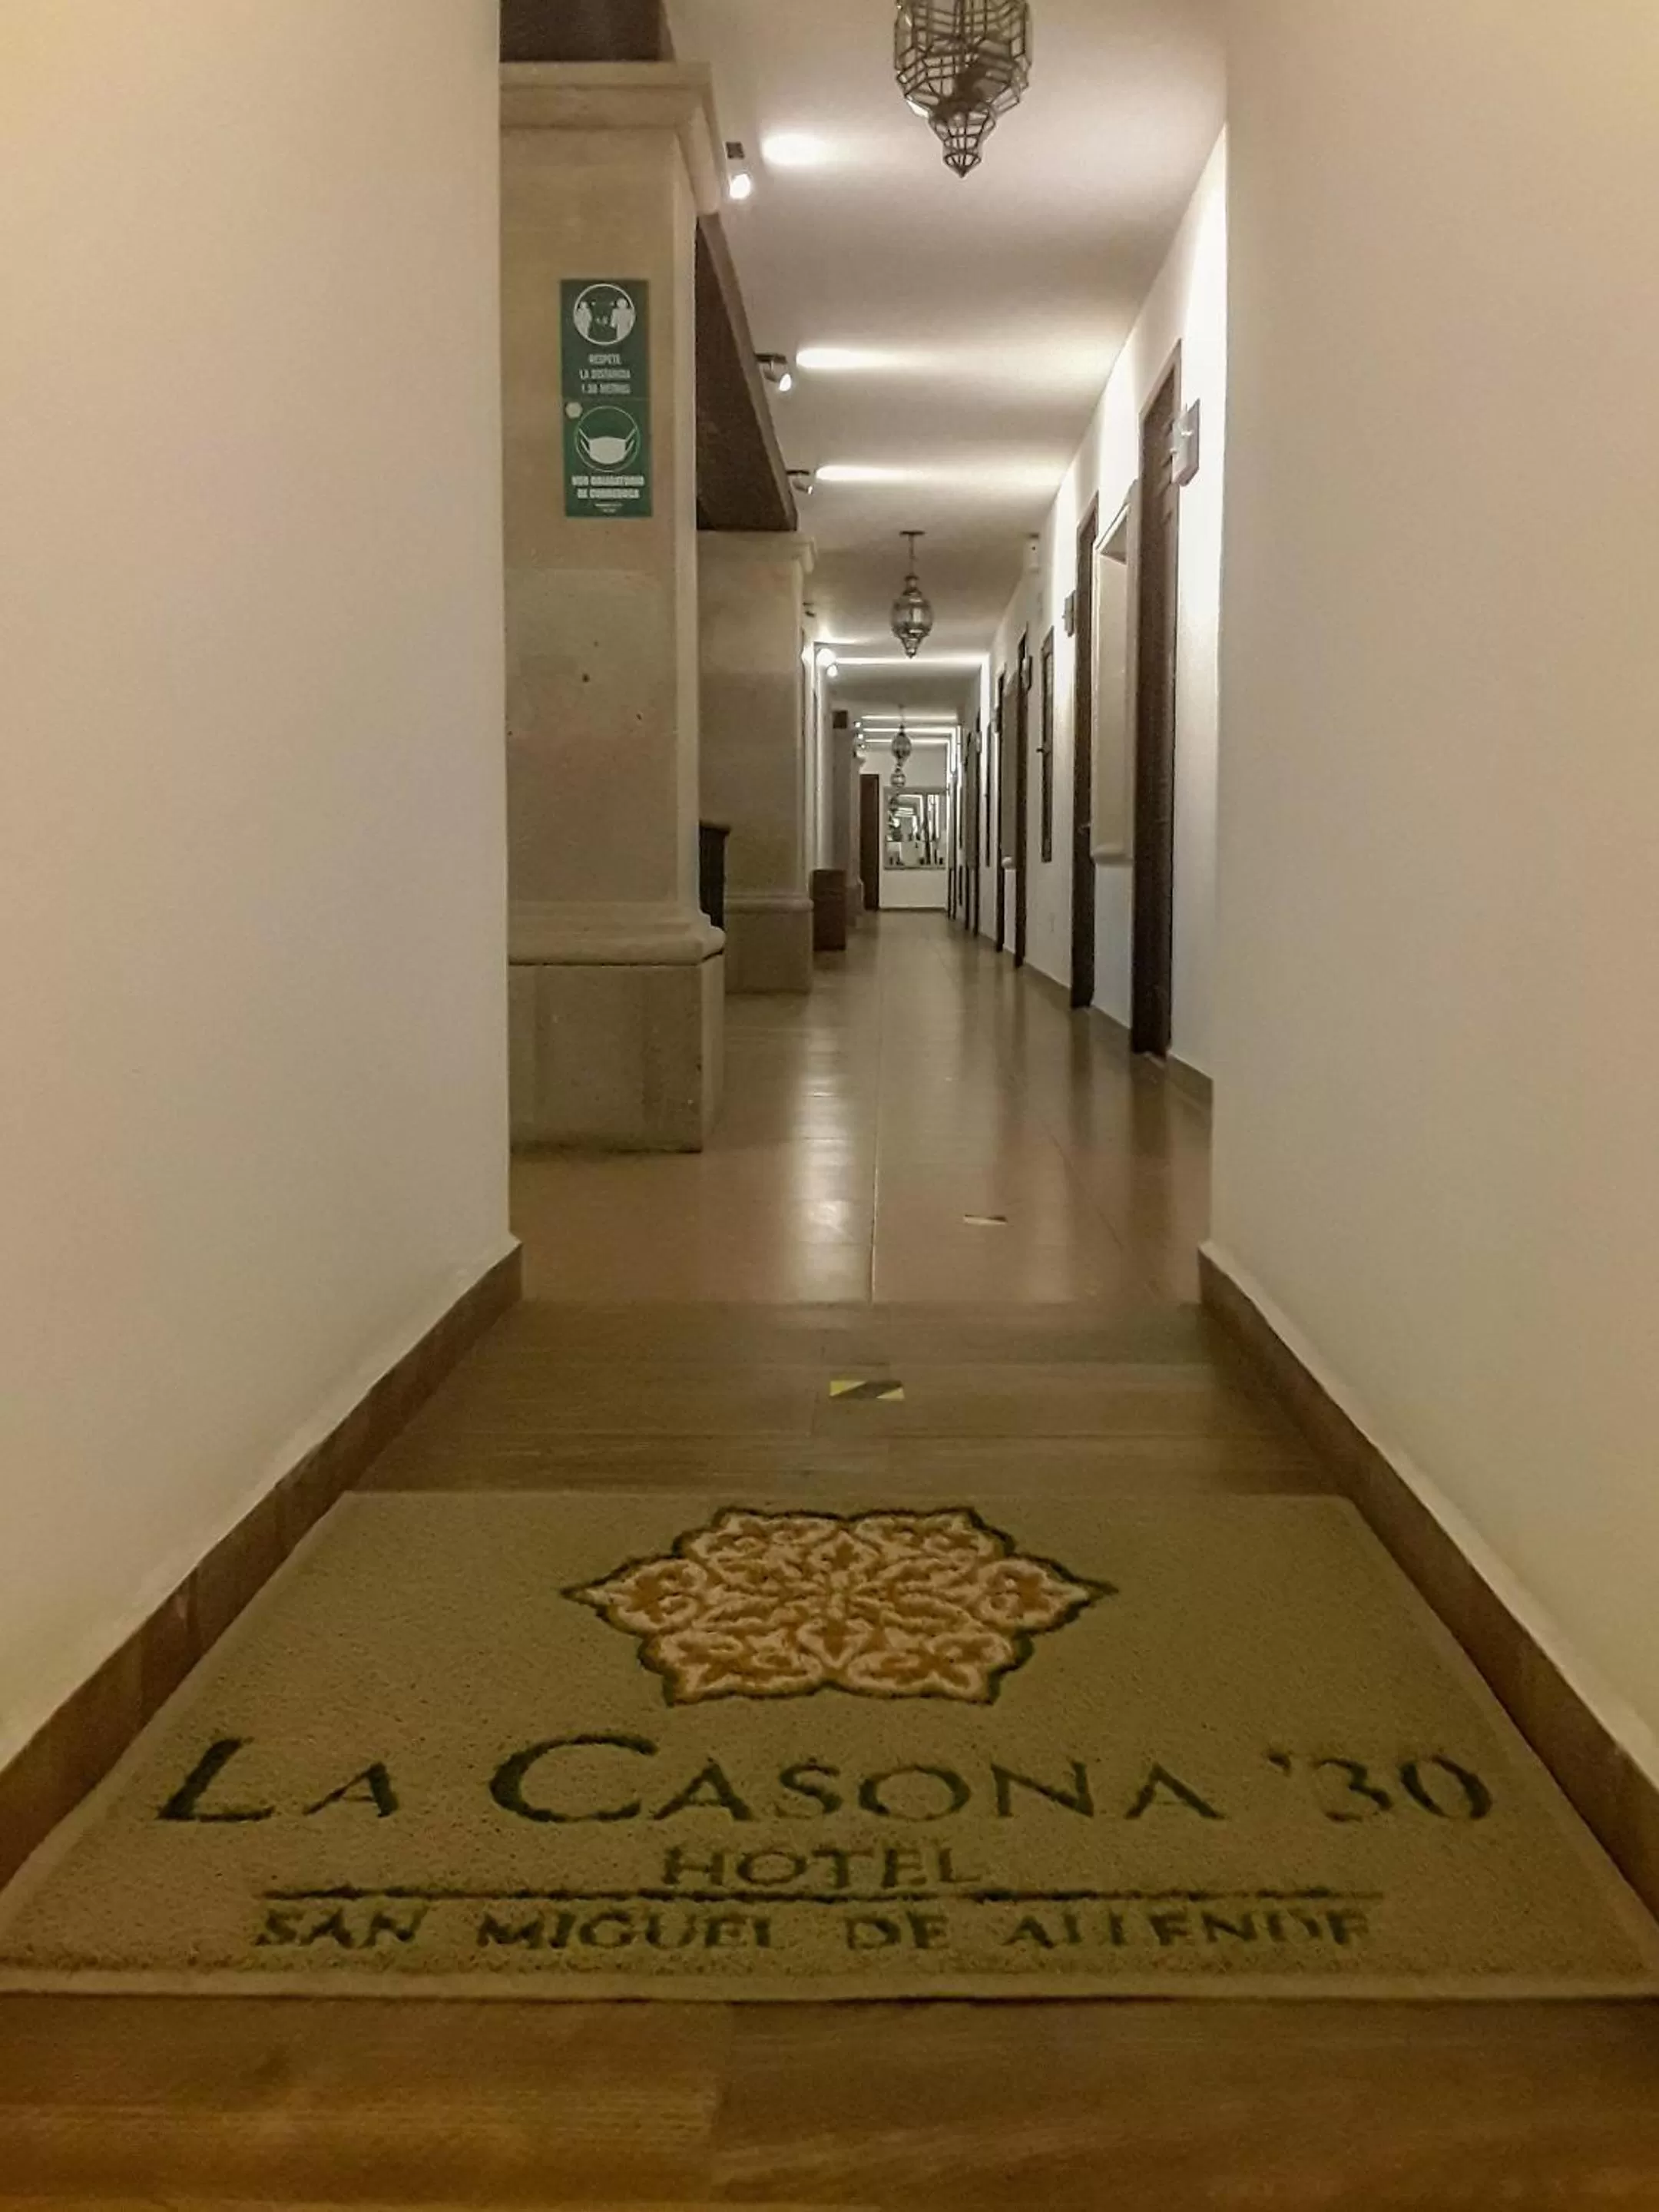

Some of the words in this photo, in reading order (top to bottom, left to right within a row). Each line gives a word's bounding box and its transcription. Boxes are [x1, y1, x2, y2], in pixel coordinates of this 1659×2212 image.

[155, 1737, 399, 1821] LA
[489, 1734, 1227, 1823] CASONA
[661, 1845, 981, 1889] HOTEL
[254, 1906, 428, 1949] SAN
[843, 1909, 950, 1949] DE
